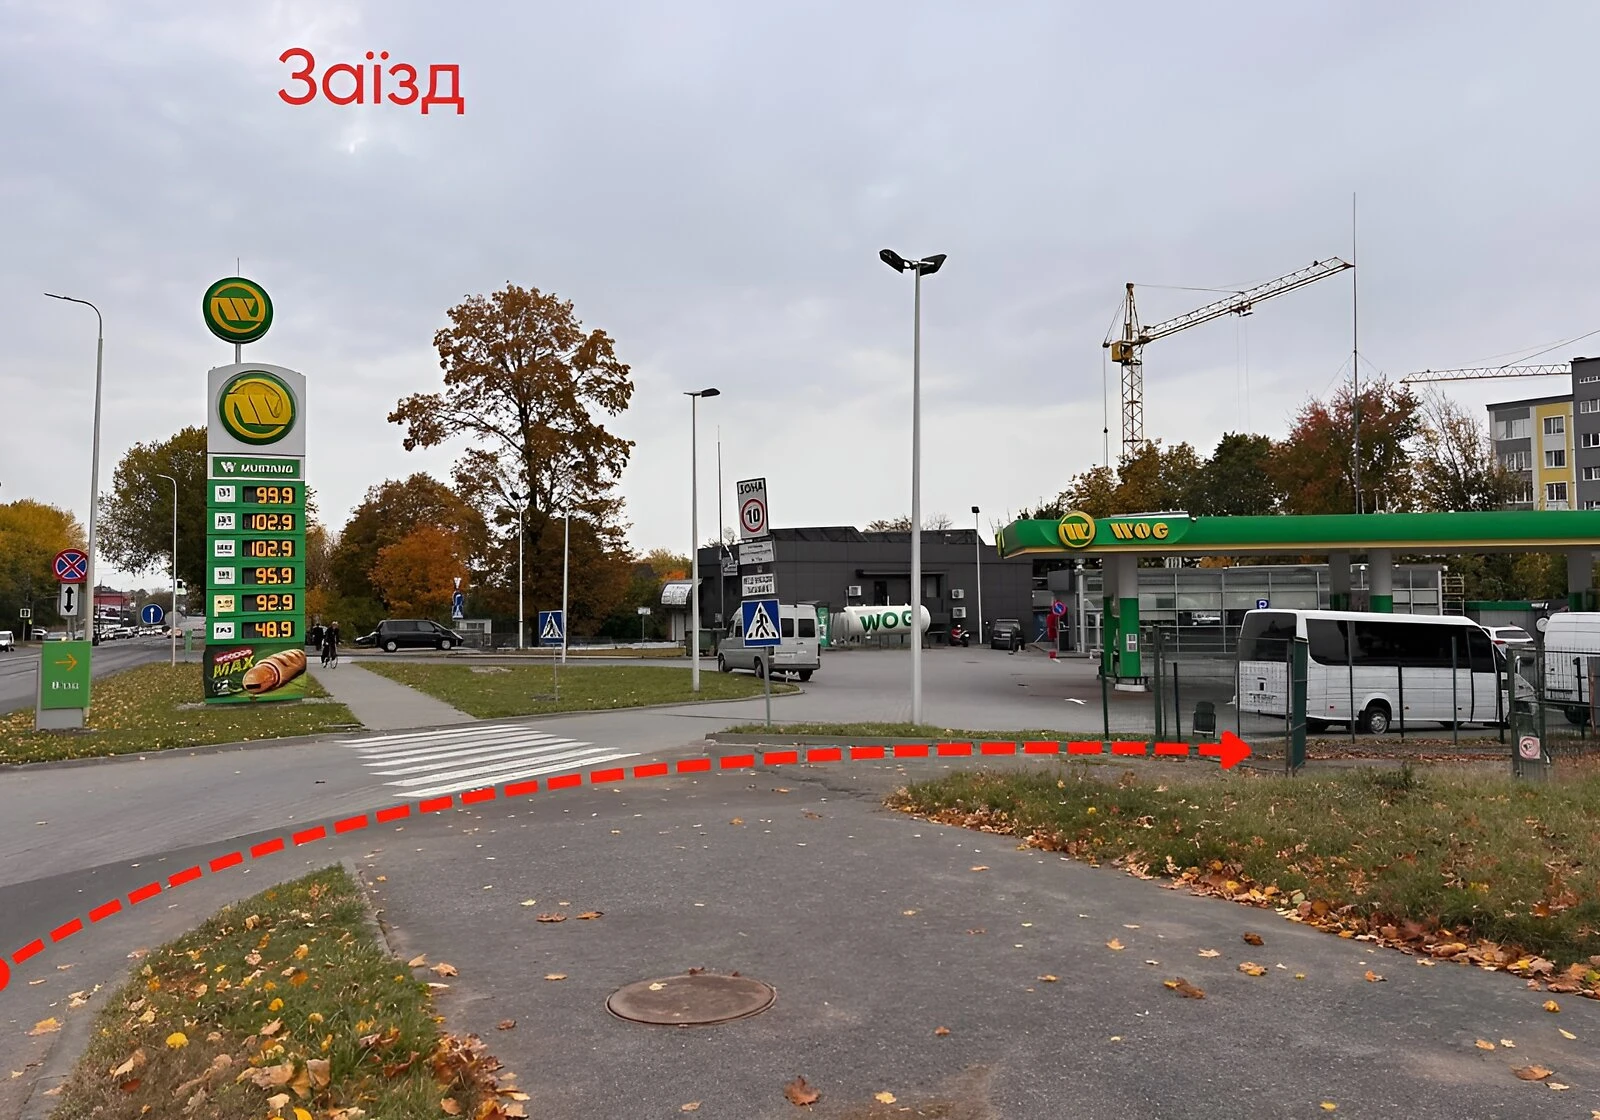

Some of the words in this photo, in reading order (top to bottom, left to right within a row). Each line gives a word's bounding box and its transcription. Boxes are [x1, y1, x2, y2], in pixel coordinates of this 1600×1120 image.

[256, 486, 293, 504] 99.9
[251, 514, 293, 531] 102.9
[745, 508, 760, 524] 10
[1109, 522, 1169, 539] WOG
[251, 540, 292, 557] 102.9
[255, 567, 292, 584] 95.9
[256, 594, 293, 611] 92.9
[255, 621, 292, 637] 48.9
[213, 655, 254, 679] MAX
